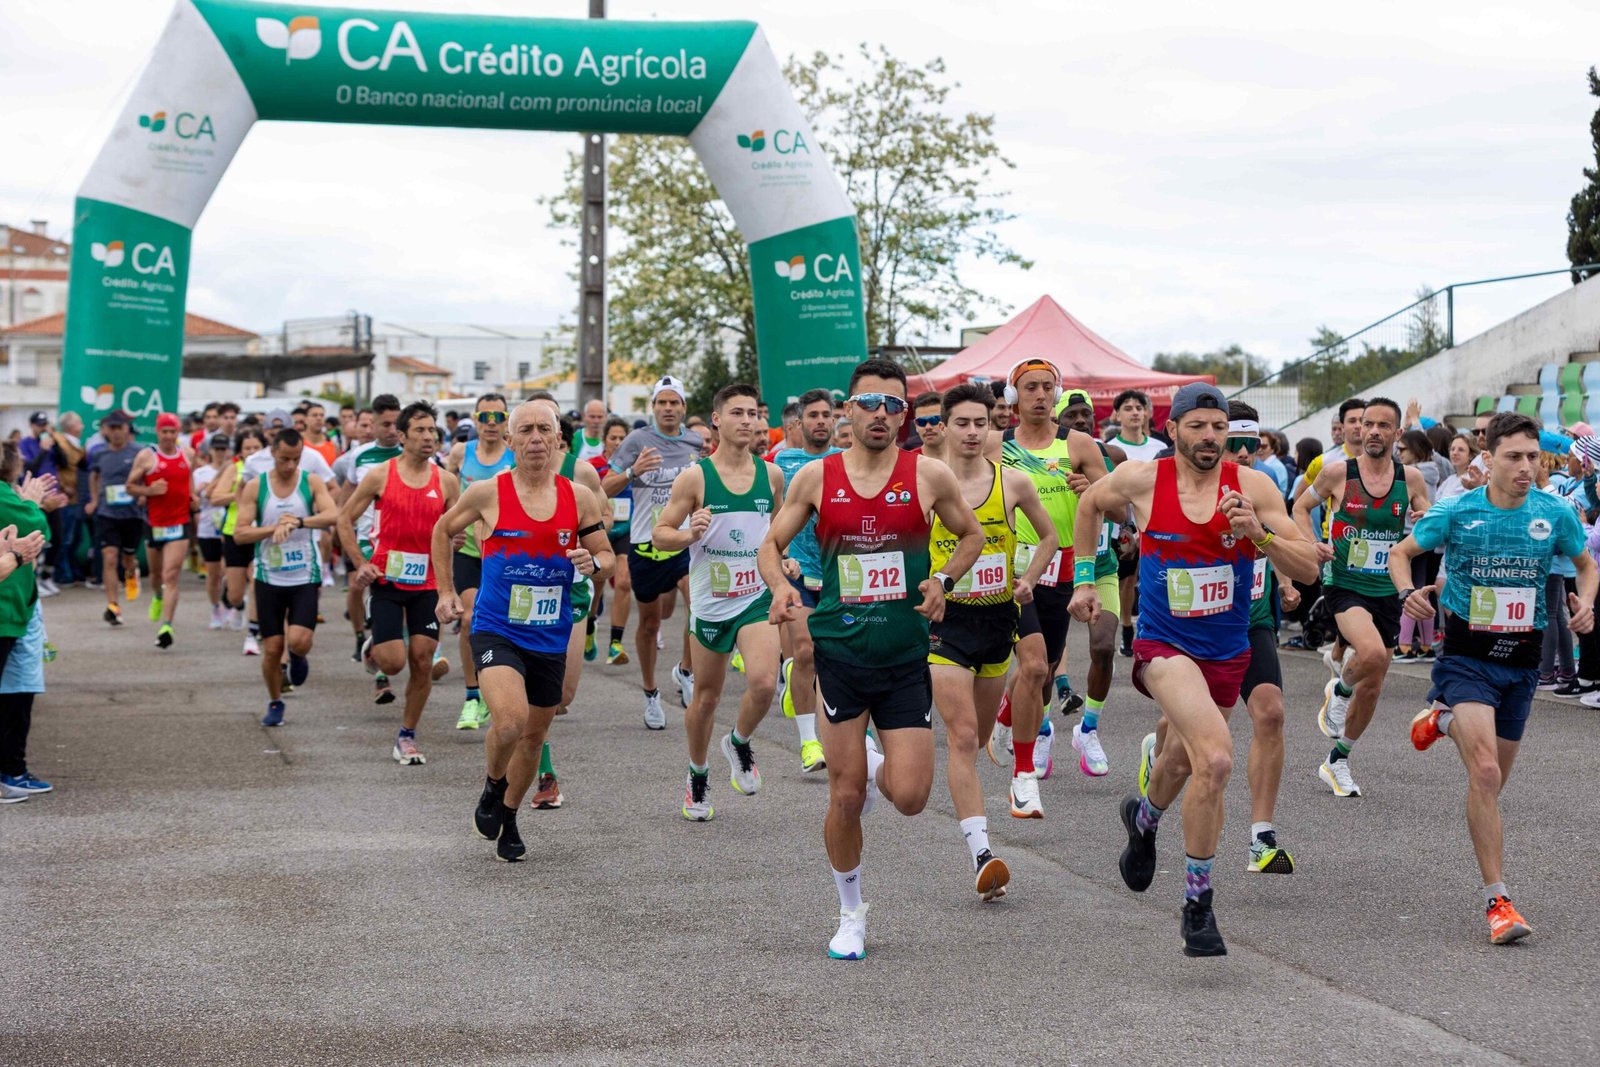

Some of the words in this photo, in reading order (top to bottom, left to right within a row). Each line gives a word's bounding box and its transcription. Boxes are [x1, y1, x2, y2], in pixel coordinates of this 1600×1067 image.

[337, 18, 428, 73] CA
[439, 41, 564, 77] Crédito
[574, 46, 707, 86] Agrícola
[336, 85, 352, 104] O
[356, 86, 418, 107] Banco
[422, 91, 505, 110] nacional
[509, 95, 551, 111] com
[555, 93, 651, 115] pronúncia
[656, 95, 703, 114] local
[174, 112, 216, 142] CA
[773, 129, 810, 155] CA
[131, 242, 176, 276] CA
[813, 253, 853, 283] CA
[790, 288, 824, 300] Crédito
[121, 386, 166, 418] CA
[842, 534, 873, 543] TERESA
[875, 533, 898, 543] LEDO
[285, 550, 303, 563] 145
[1375, 551, 1390, 565] 91
[1472, 555, 1489, 567] HB
[405, 563, 426, 576] 220
[735, 569, 756, 587] 211
[867, 567, 901, 589] 212
[976, 566, 1004, 586] 169
[1471, 567, 1538, 579] RUNNERS
[1200, 581, 1229, 603] 175
[537, 598, 557, 615] 178
[1506, 602, 1526, 620] 10
[1492, 644, 1514, 653] RESS
[1497, 638, 1520, 647] COMP
[1487, 651, 1511, 659] PORT
